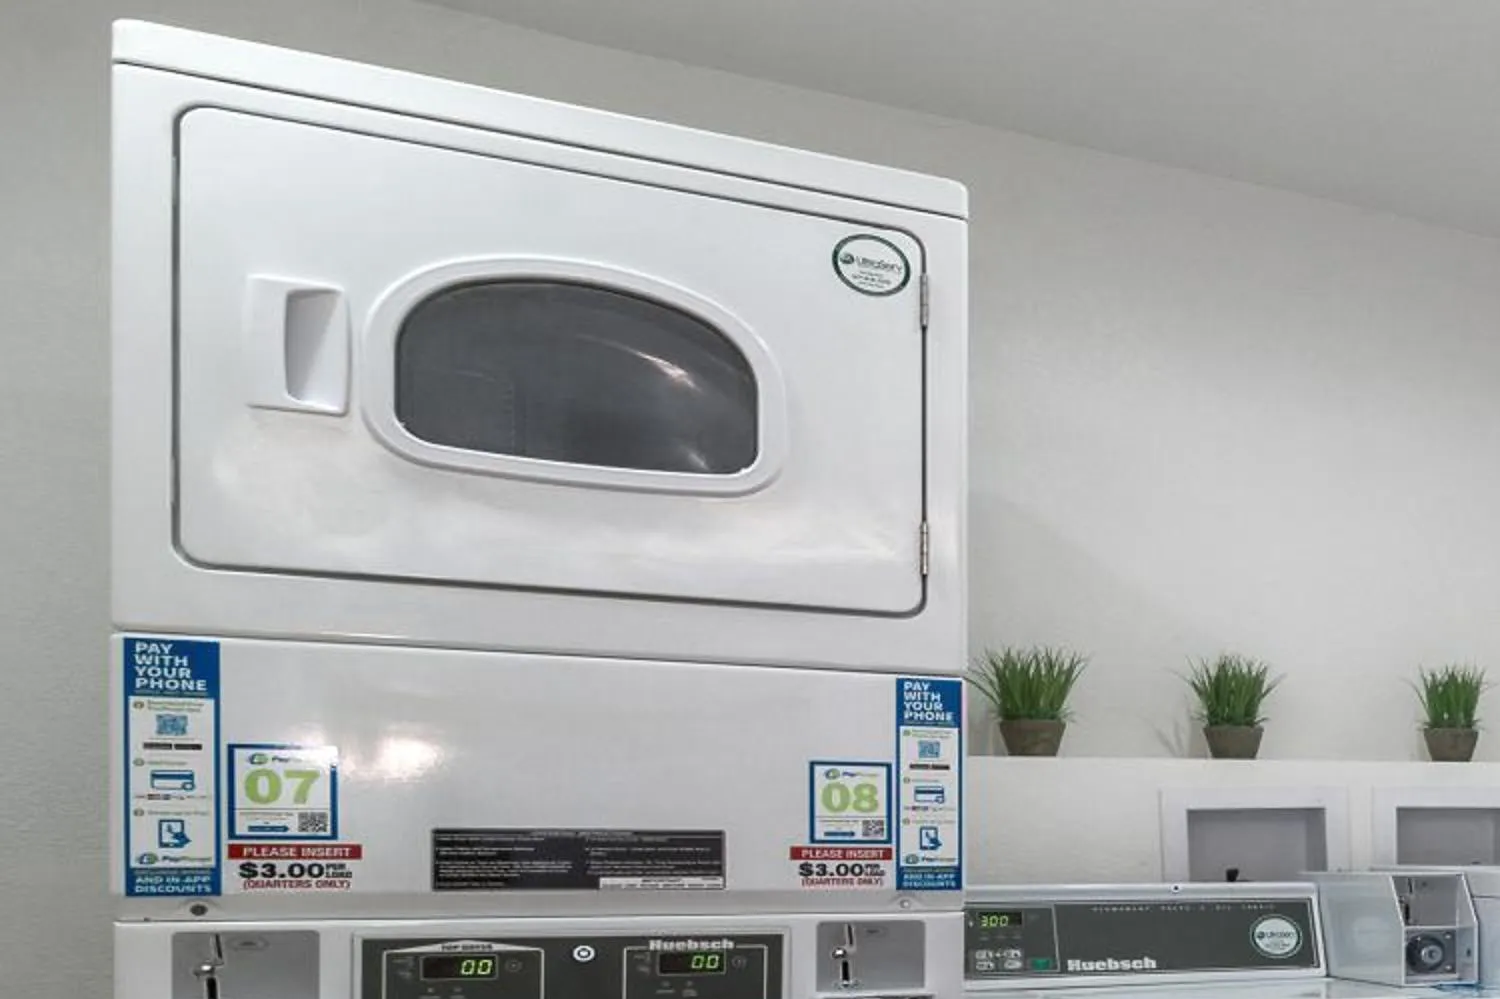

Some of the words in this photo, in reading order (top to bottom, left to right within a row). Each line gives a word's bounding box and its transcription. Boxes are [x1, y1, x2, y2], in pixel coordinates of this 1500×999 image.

[135, 641, 173, 654] PAY
[134, 654, 189, 667] WITH
[134, 665, 192, 679] YOUR
[135, 678, 208, 691] PHONE
[903, 681, 931, 691] PAY
[903, 691, 942, 701] WITH
[903, 701, 944, 711] YOUR
[903, 710, 955, 721] PHONE
[244, 767, 321, 805] 07
[821, 782, 879, 814] 08
[242, 846, 298, 857] PLEASE
[301, 846, 352, 857] INSERT
[801, 849, 843, 859] PLEASE
[845, 849, 885, 859] INSERT
[238, 861, 325, 879] $3.00
[798, 861, 865, 878] $3.00
[135, 884, 212, 894] DISCOUNTS
[243, 879, 313, 890] (QUARTERS
[315, 879, 351, 889] ONLY)
[980, 915, 1010, 928] 300
[648, 938, 735, 951] Huebsch
[460, 959, 493, 976] 00
[690, 955, 720, 969] 00
[1066, 956, 1158, 972] Huebsch
